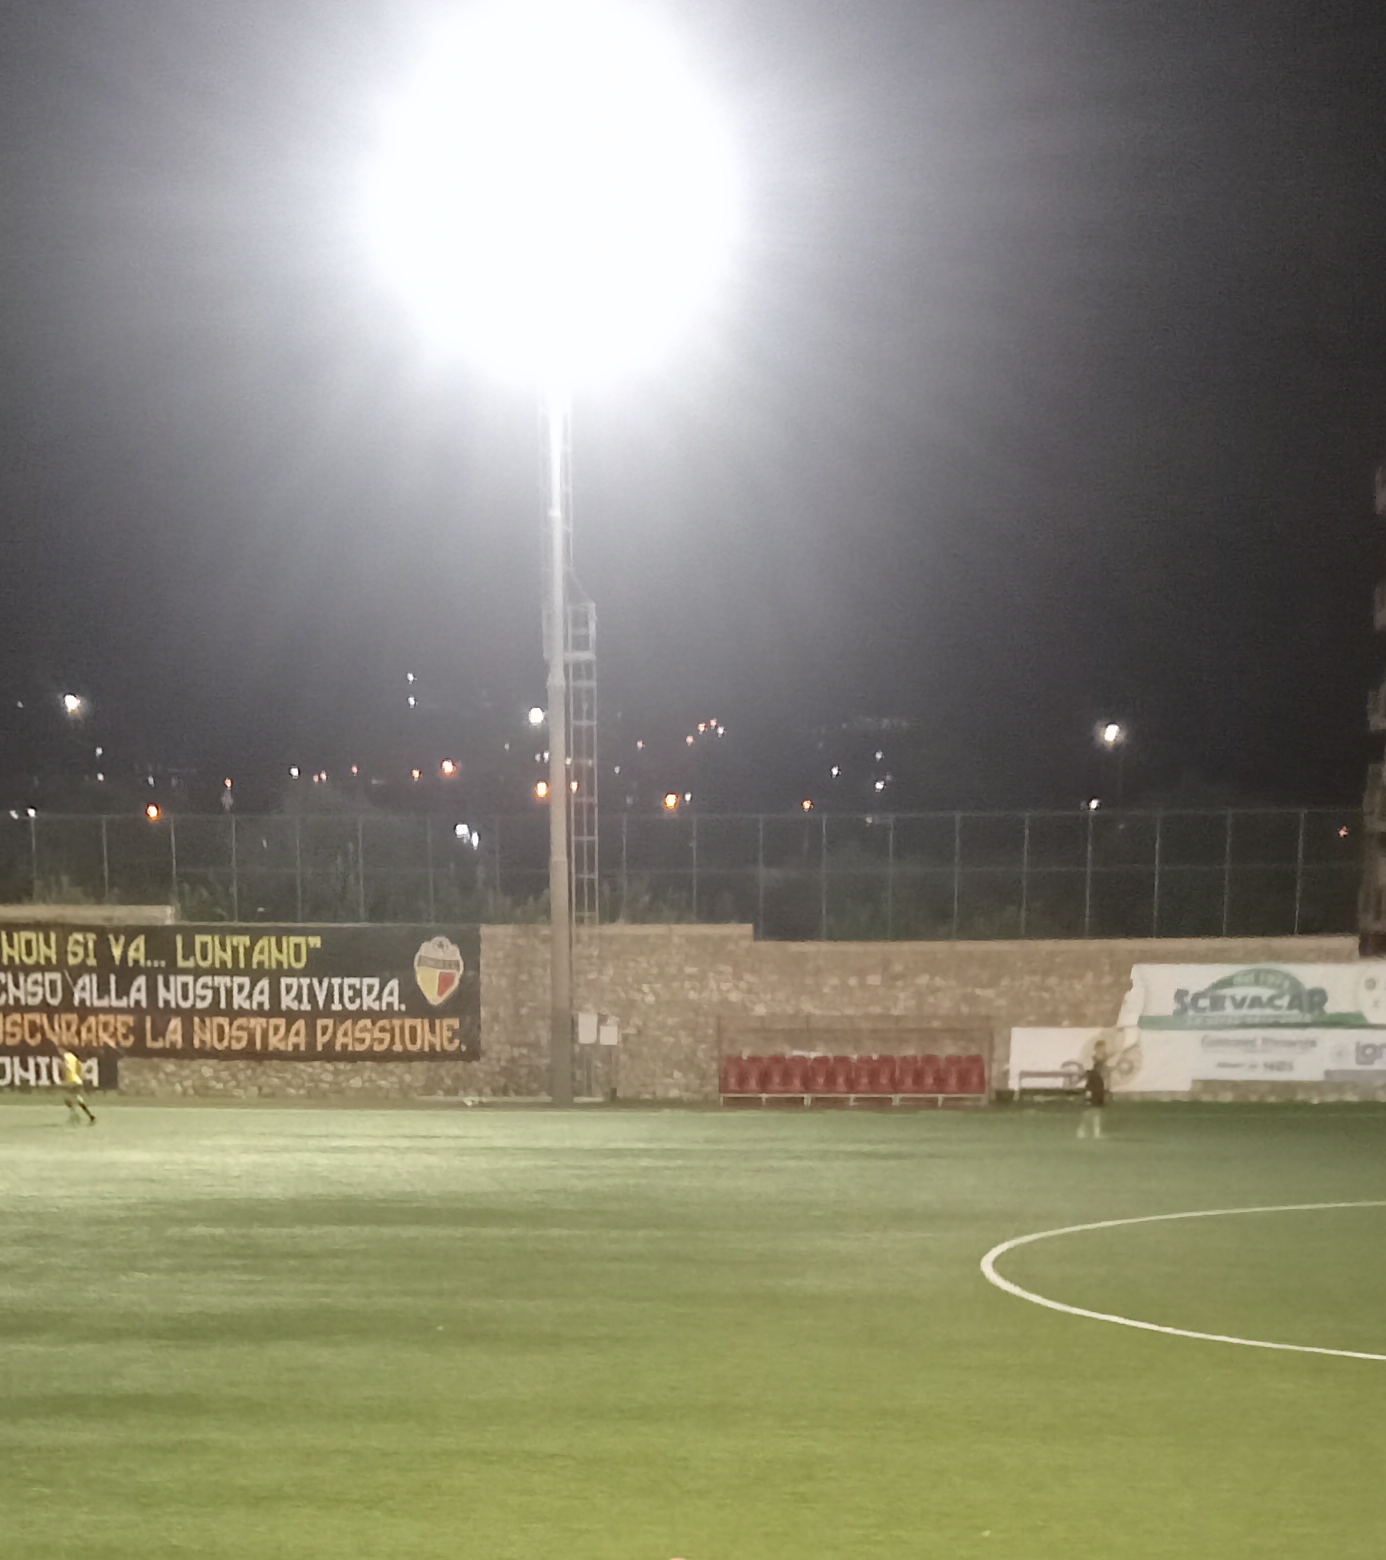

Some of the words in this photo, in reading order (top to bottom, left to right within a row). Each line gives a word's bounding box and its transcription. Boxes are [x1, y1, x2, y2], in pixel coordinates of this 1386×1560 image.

[1, 930, 57, 966] NON
[67, 931, 98, 967] SI
[73, 973, 147, 1009] ALLA
[157, 974, 270, 1010] NOSTRA
[280, 976, 407, 1012] RIVIERA.
[145, 1015, 183, 1050] LA
[193, 1016, 306, 1051] NOSTRA
[316, 1018, 466, 1052] PASSIONE.
